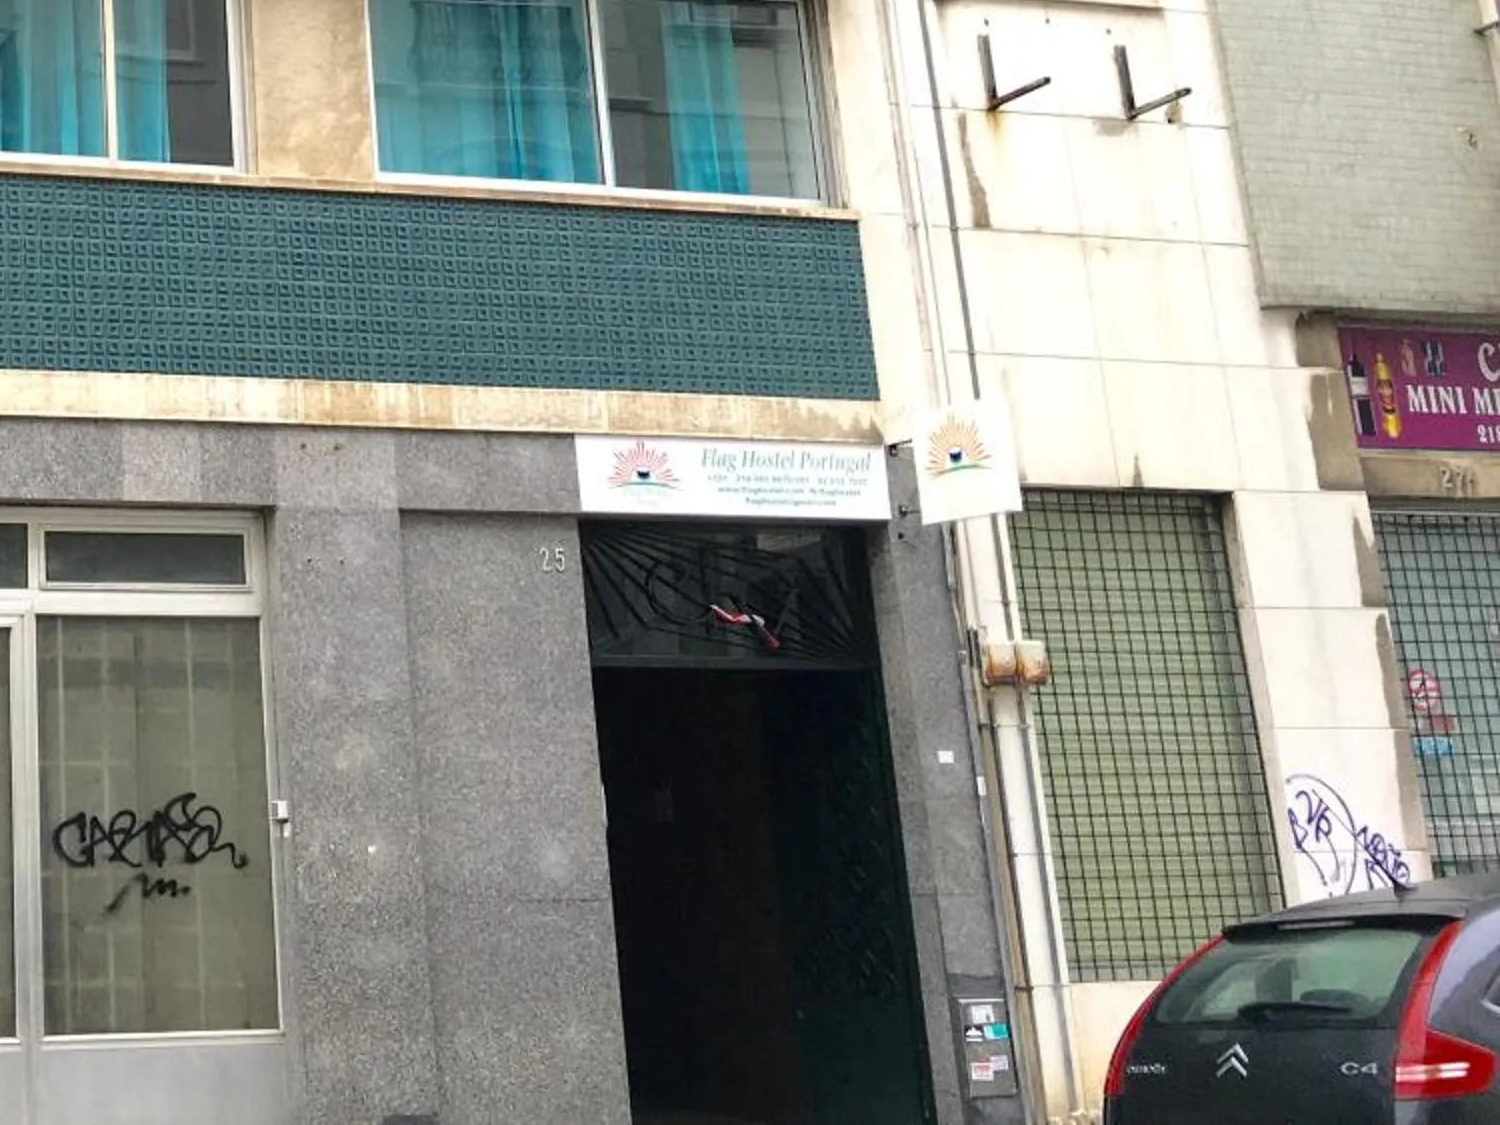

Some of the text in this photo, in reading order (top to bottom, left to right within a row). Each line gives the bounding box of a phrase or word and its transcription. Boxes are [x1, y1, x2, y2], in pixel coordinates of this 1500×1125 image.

[1477, 342, 1500, 382] C
[1405, 385, 1468, 414] MINI
[701, 448, 872, 475] Flag Hostel Portugal
[539, 546, 565, 572] 25
[1340, 1061, 1379, 1075] C4
